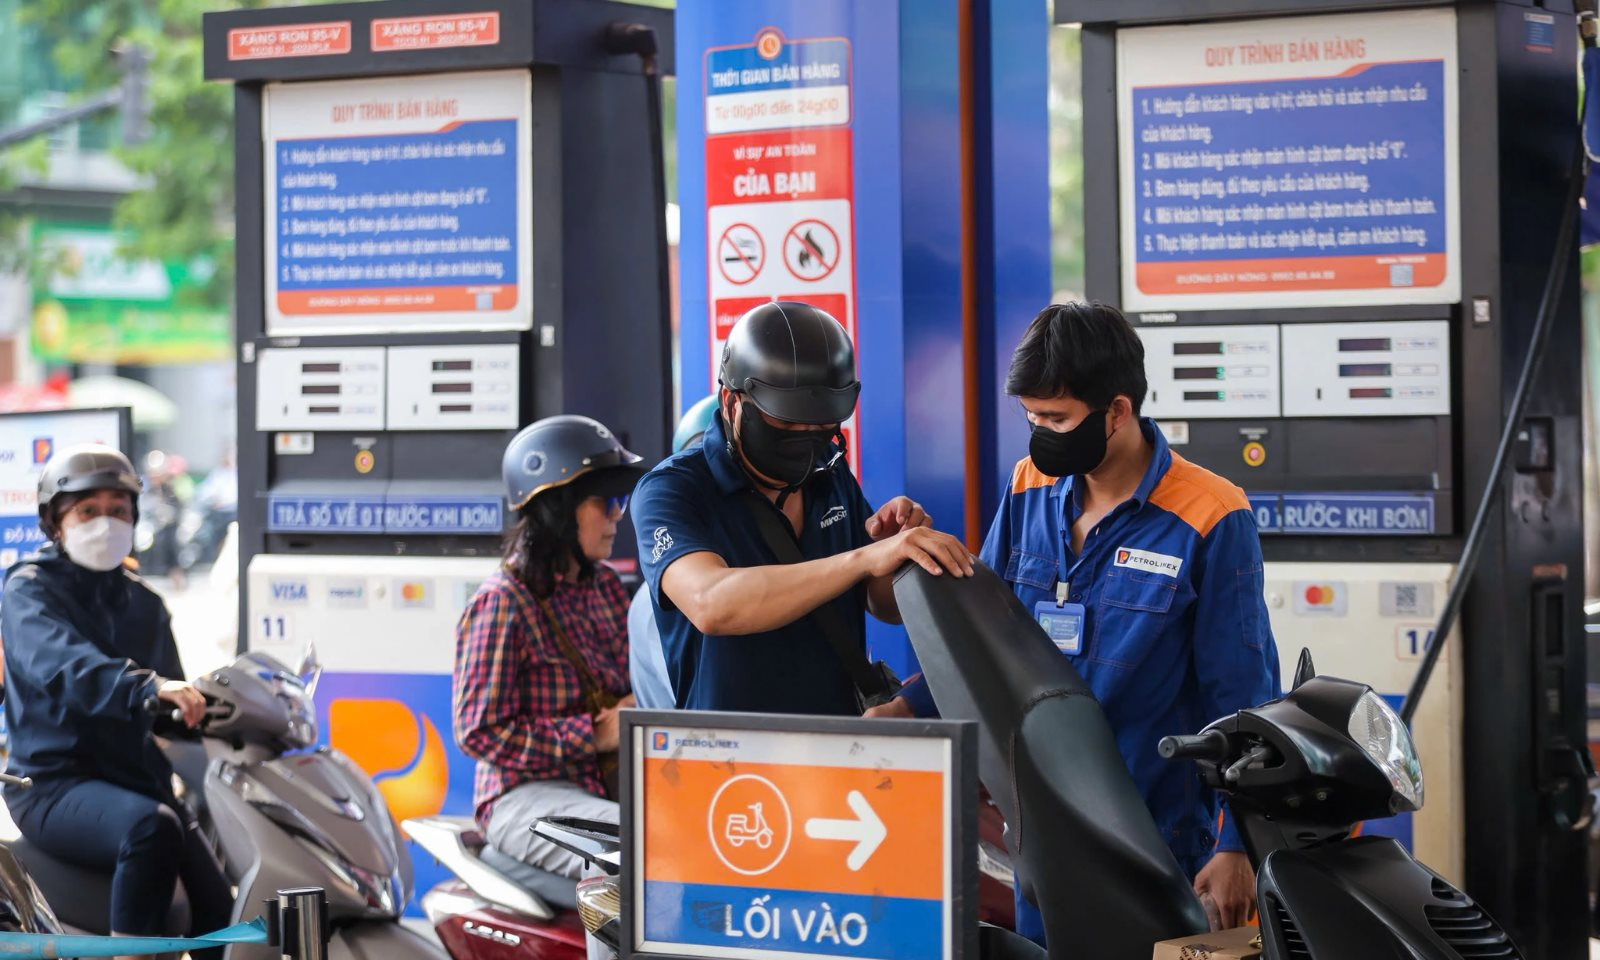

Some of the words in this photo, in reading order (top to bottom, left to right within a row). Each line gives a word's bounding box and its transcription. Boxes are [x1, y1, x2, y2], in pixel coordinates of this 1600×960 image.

[1205, 47, 1233, 67] QUY
[1239, 41, 1284, 65] TRÌNH
[1288, 37, 1319, 63] BÁN
[1323, 35, 1366, 61] HÀNG
[713, 67, 739, 88] THỜI
[741, 67, 770, 85] GIAN
[771, 63, 799, 82] BÁN
[801, 61, 840, 80] HÀNG
[733, 144, 746, 161] VÌ
[747, 146, 764, 162] SỰ
[765, 145, 783, 158] AN
[784, 142, 817, 157] TOÀN
[733, 167, 771, 198] CỦA
[774, 171, 817, 199] BẠN
[278, 499, 306, 526] TRẢ
[309, 497, 331, 527] SỐ
[335, 498, 357, 526] VỀ
[375, 502, 429, 528] TRƯỚC
[431, 507, 457, 528] KHI
[460, 506, 497, 528] BƠM
[1257, 506, 1271, 527] 0
[1346, 507, 1378, 528] KHI
[1382, 505, 1427, 528] BƠM
[272, 584, 307, 600] VISA
[262, 616, 286, 639] 11
[675, 738, 740, 750] PETROLIMEX
[725, 894, 780, 940] LỐI
[791, 901, 868, 946] VÀO
